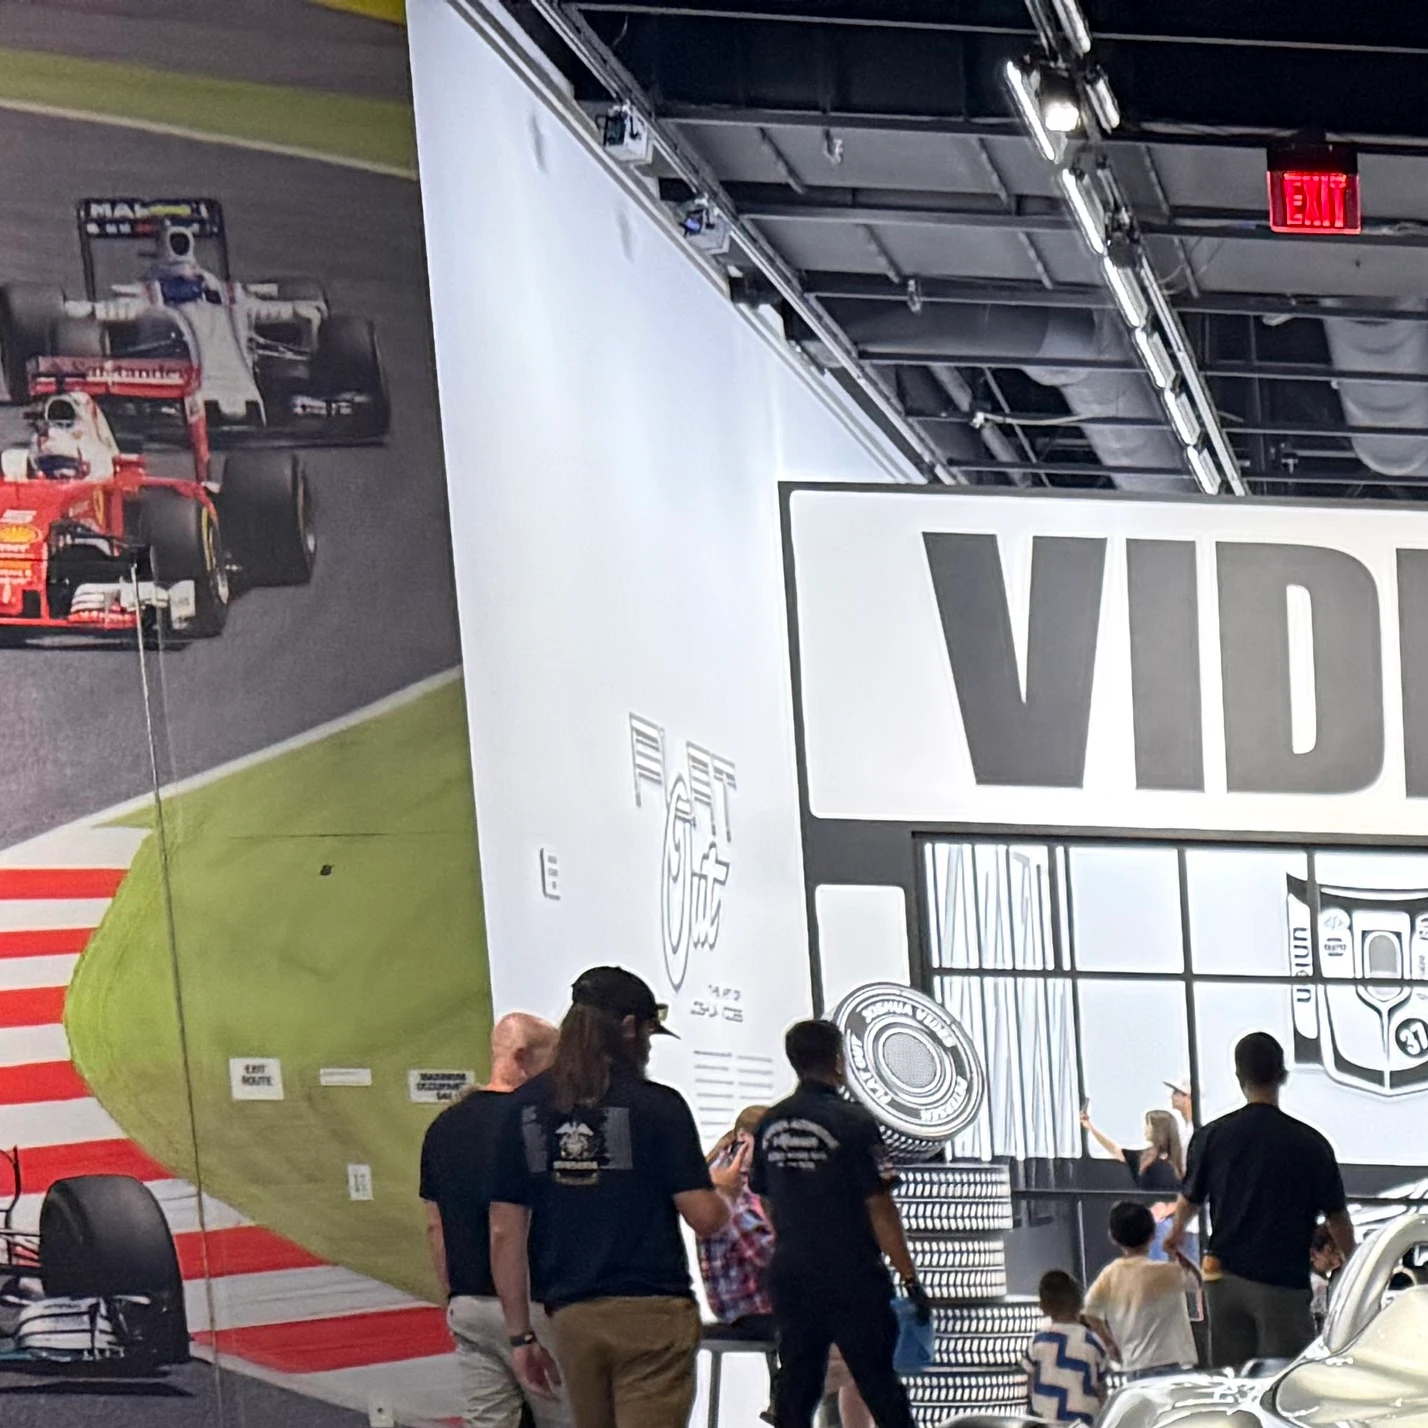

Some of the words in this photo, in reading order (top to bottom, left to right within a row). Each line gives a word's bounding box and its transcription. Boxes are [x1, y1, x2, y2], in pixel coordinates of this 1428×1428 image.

[1284, 173, 1347, 228] EXIT
[1399, 1021, 1428, 1056] 37
[241, 1075, 273, 1087] ROUTE
